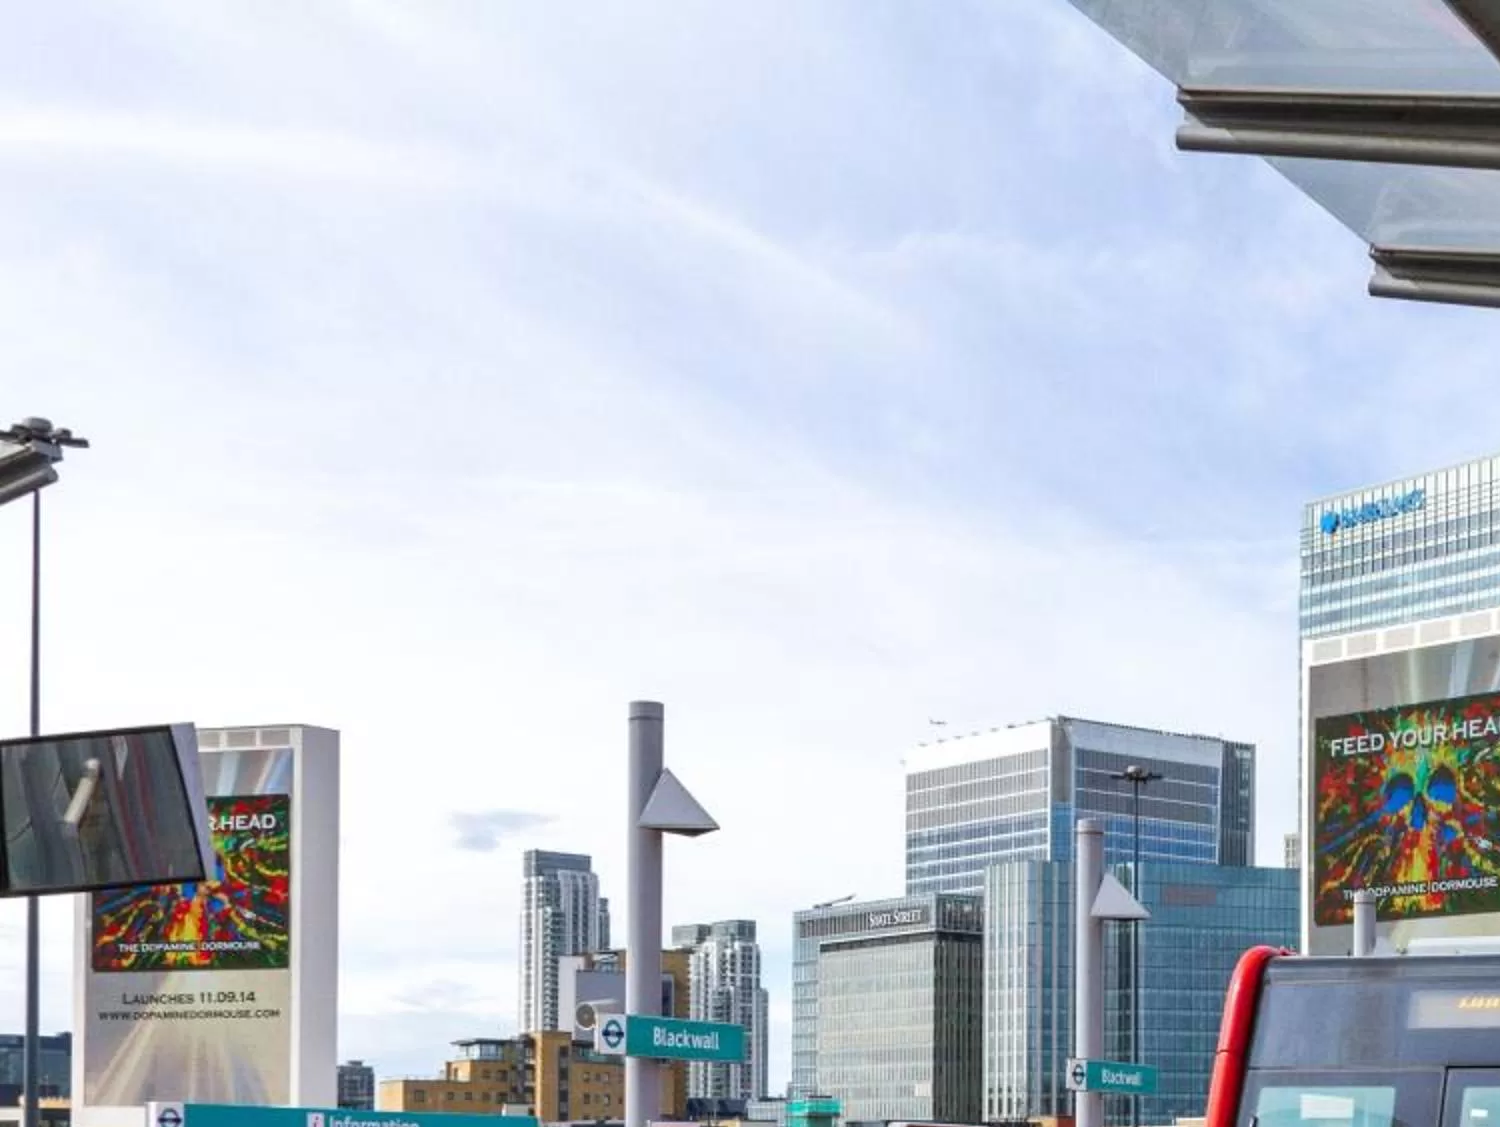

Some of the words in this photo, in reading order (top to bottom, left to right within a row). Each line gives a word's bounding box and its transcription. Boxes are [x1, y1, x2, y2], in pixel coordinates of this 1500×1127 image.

[1330, 732, 1385, 757] FEED
[1389, 724, 1448, 749] YOUR
[222, 813, 277, 831] HEAD
[1431, 876, 1499, 893] DORMOUSE
[118, 942, 140, 953] THE
[141, 941, 196, 953] DOPAMINE
[201, 940, 261, 951] DORMOUSE
[199, 990, 256, 1004] 11.09.14
[652, 1025, 721, 1051] Blackwall
[1101, 1068, 1143, 1087] Blackwall
